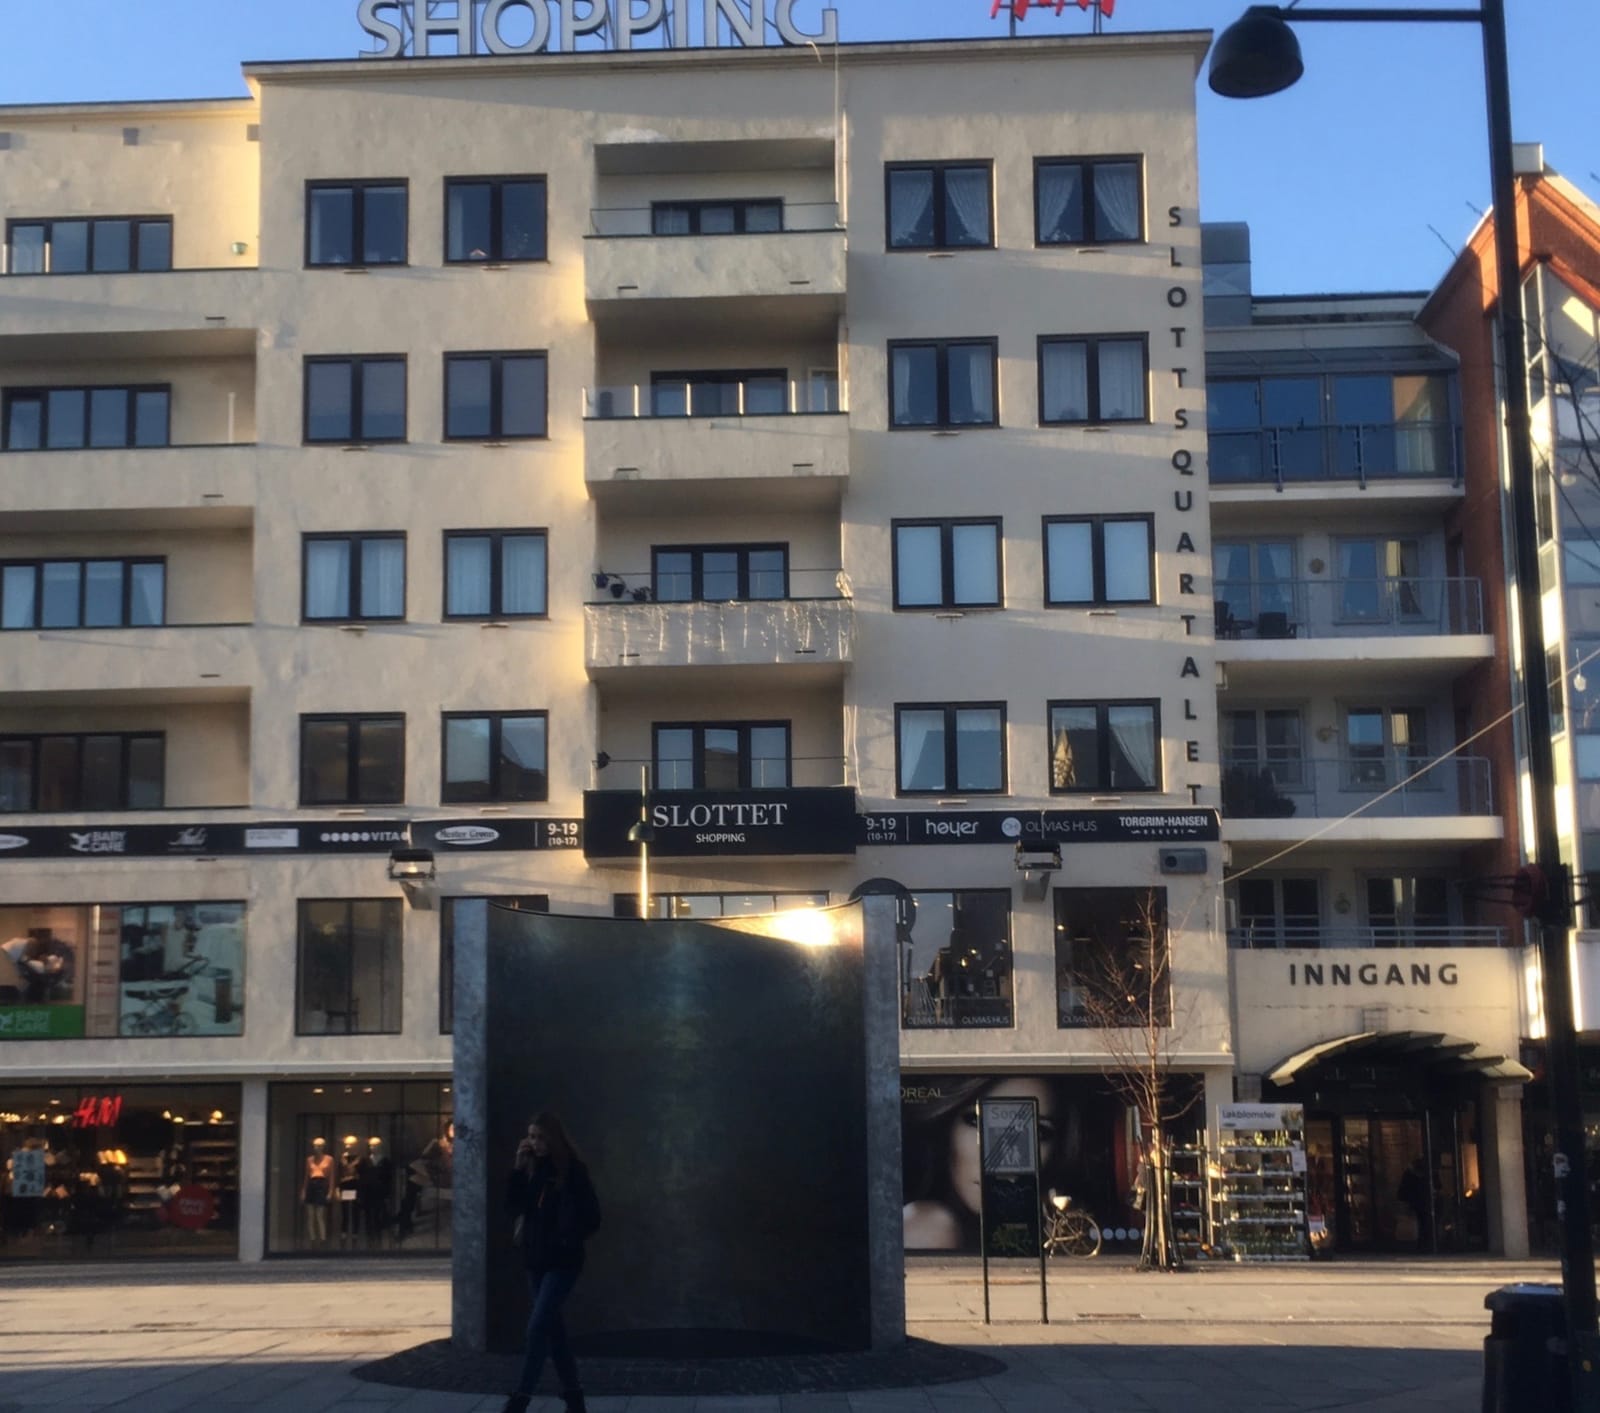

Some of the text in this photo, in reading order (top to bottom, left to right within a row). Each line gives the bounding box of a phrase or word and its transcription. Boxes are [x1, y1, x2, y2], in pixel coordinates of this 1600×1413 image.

[358, 0, 838, 59] SHOPPING
[1168, 206, 1202, 805] SLOTTSQUARTALET
[652, 803, 788, 828] SLOTTET
[547, 822, 578, 836] 9-19
[866, 817, 897, 830] 9-19
[1072, 820, 1097, 831] HUS
[370, 832, 400, 842] VITA
[548, 837, 578, 847] (10-17)
[696, 833, 746, 843] SHOPPING
[866, 832, 897, 842] (10-17)
[1289, 963, 1459, 986] INNGANG
